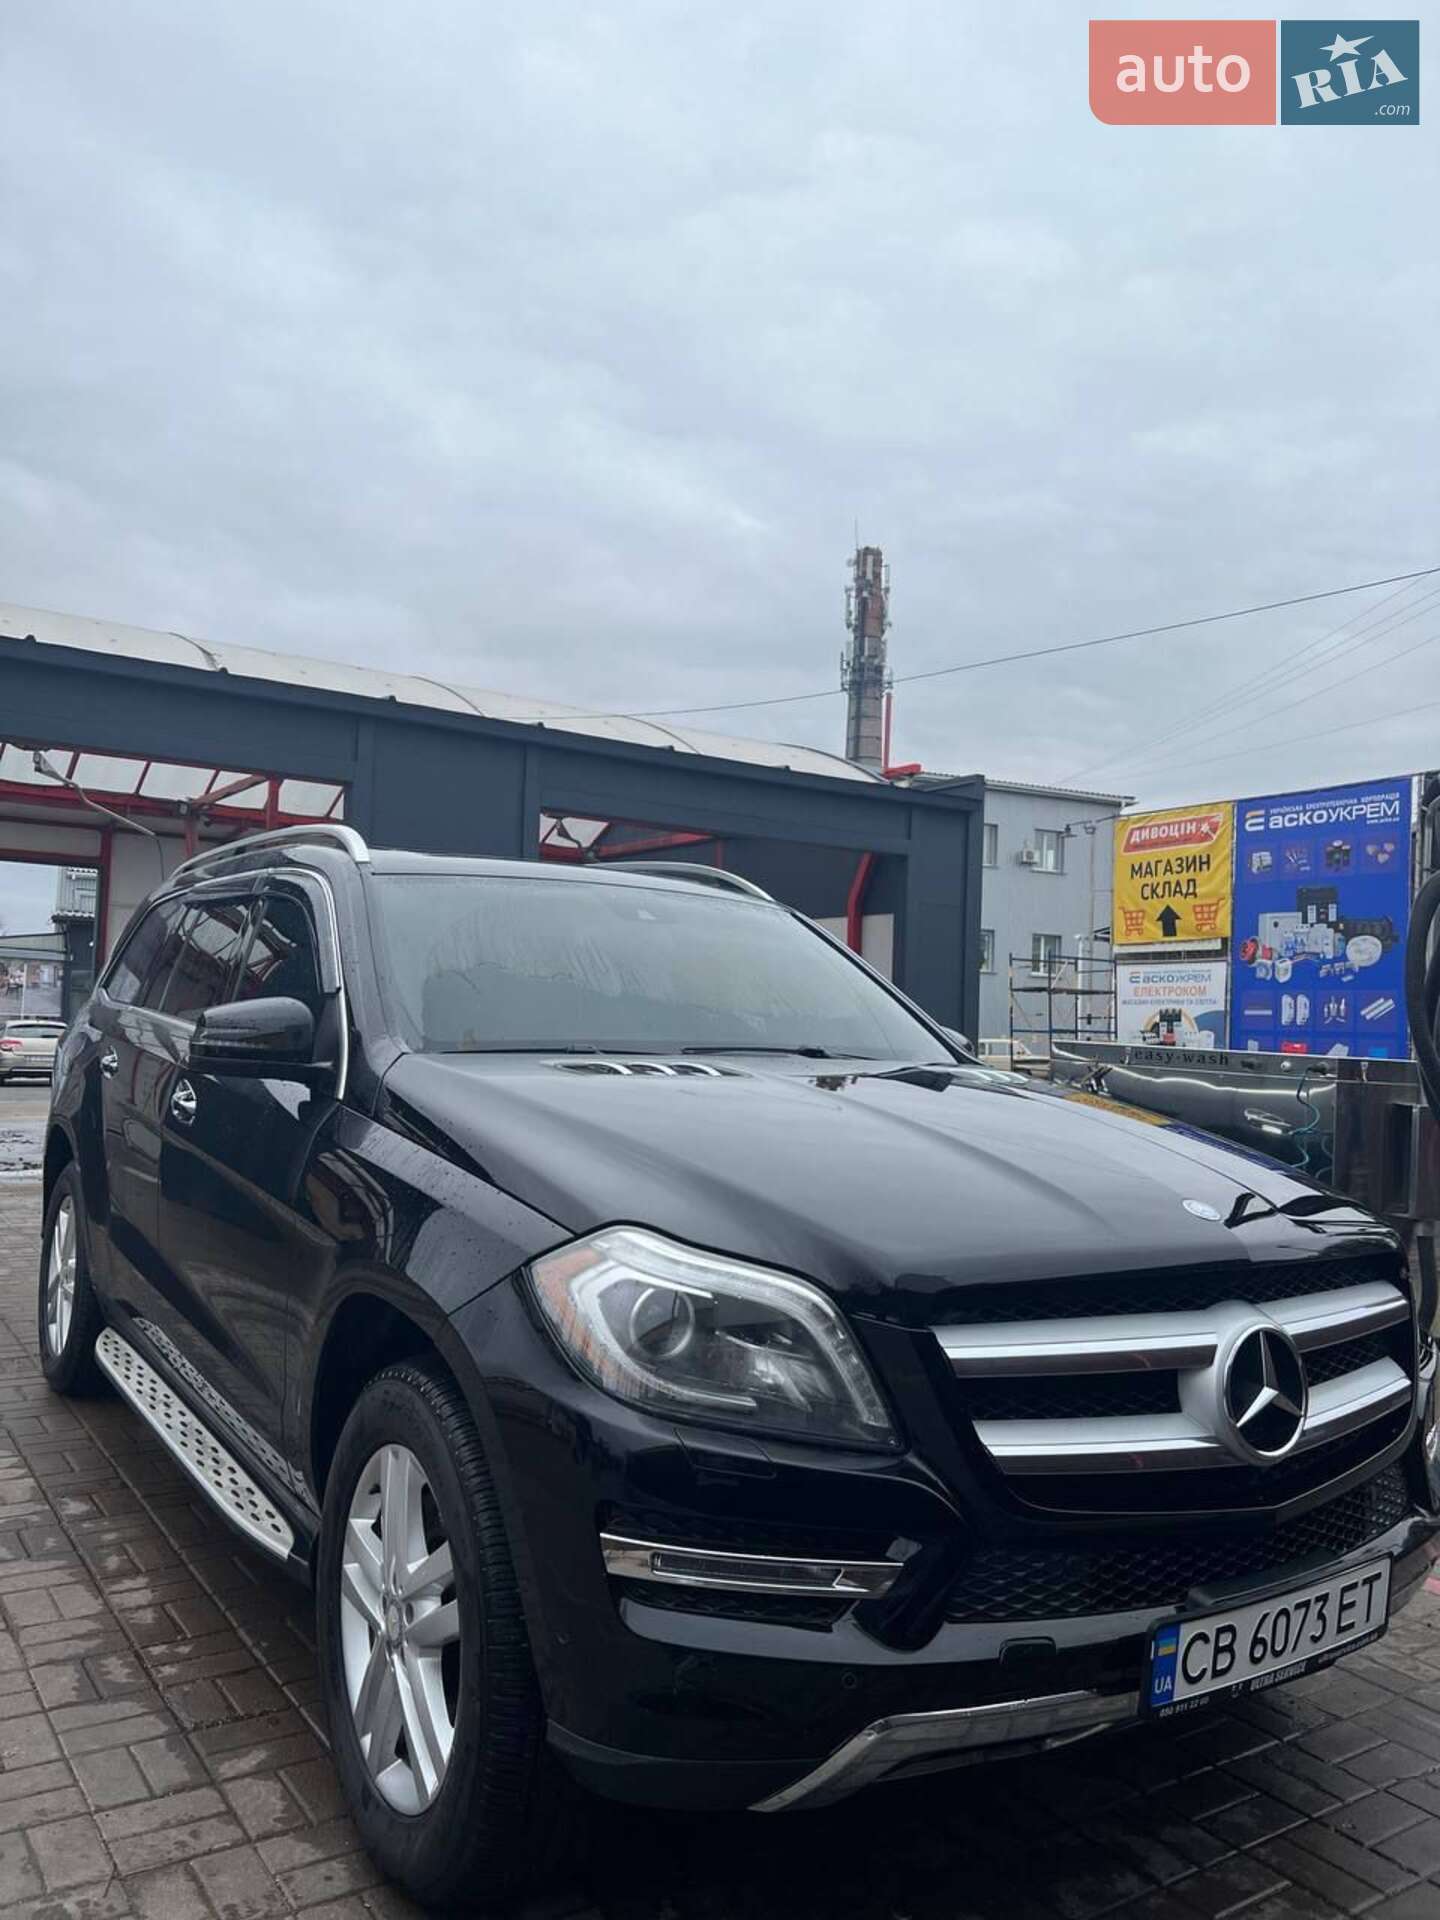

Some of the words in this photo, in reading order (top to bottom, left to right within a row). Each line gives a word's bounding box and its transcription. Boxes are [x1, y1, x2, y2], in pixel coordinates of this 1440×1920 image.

[1129, 821, 1197, 845] ДИВОЦІН
[1130, 853, 1211, 880] МАГАЗИН
[1140, 877, 1198, 901] СКЛАД
[1134, 985, 1208, 997] ЕЛЕКТРОКОМ
[1181, 1623, 1238, 1686] CB
[1248, 1591, 1330, 1666] 6073
[1335, 1571, 1383, 1635] ET
[1154, 1674, 1173, 1695] UA
